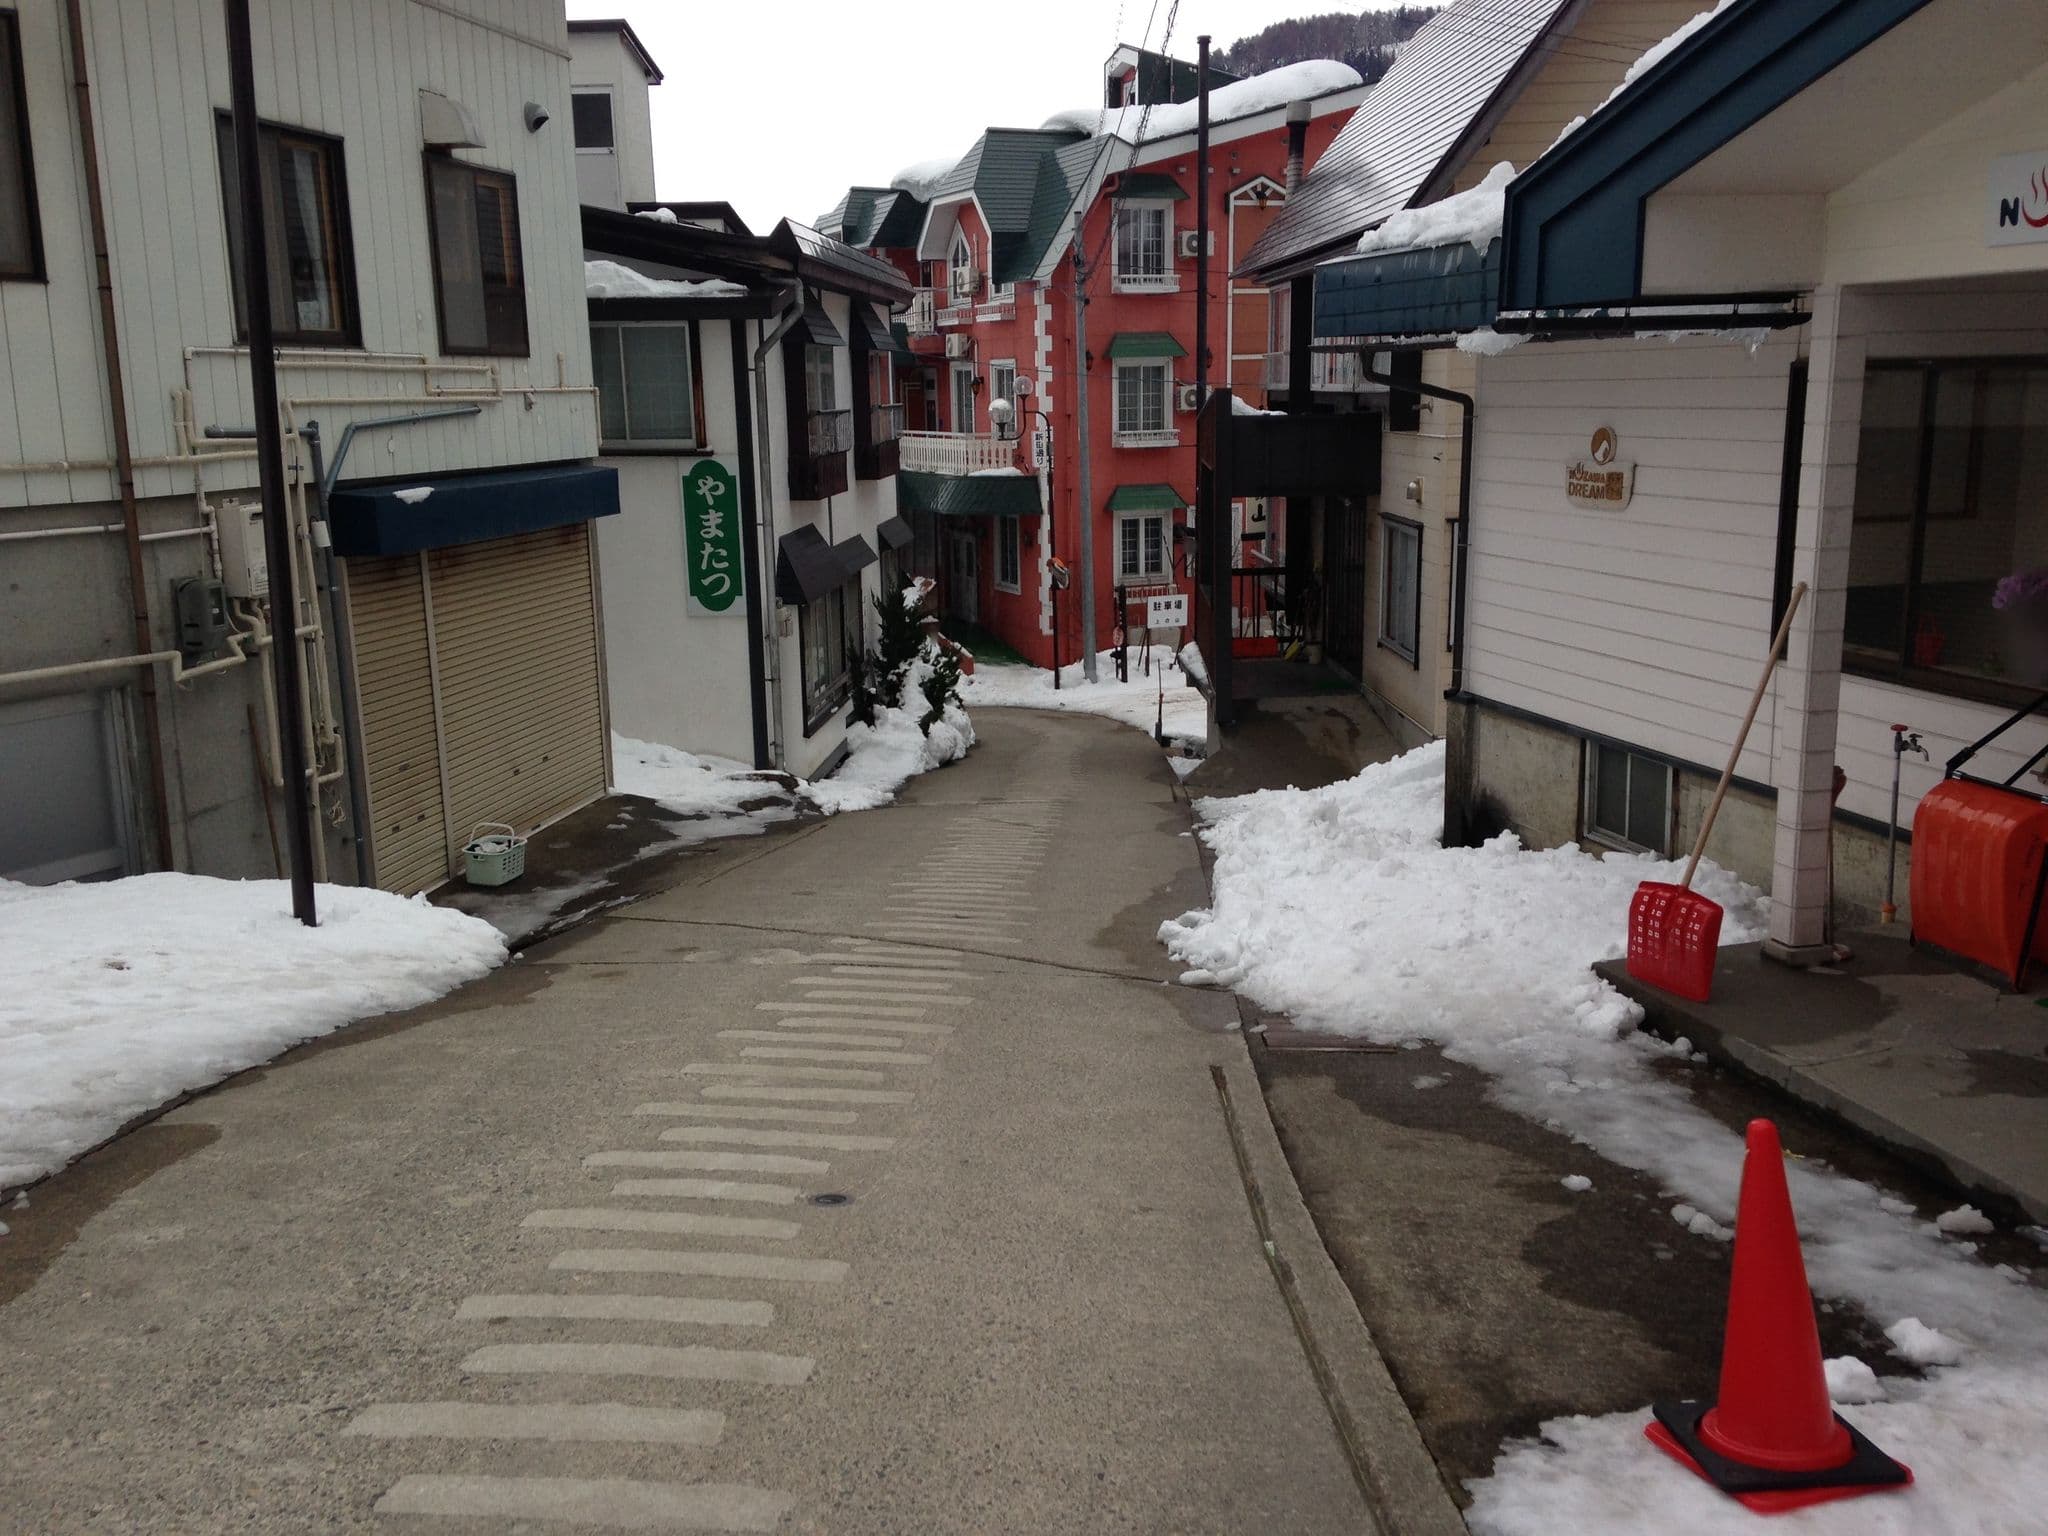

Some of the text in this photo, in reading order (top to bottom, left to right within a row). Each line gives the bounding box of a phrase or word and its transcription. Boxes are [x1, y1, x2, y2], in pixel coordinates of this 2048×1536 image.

[1568, 481, 1605, 500] DREAM
[696, 475, 731, 597] やまたつ
[1153, 600, 1182, 611] 駐車場
